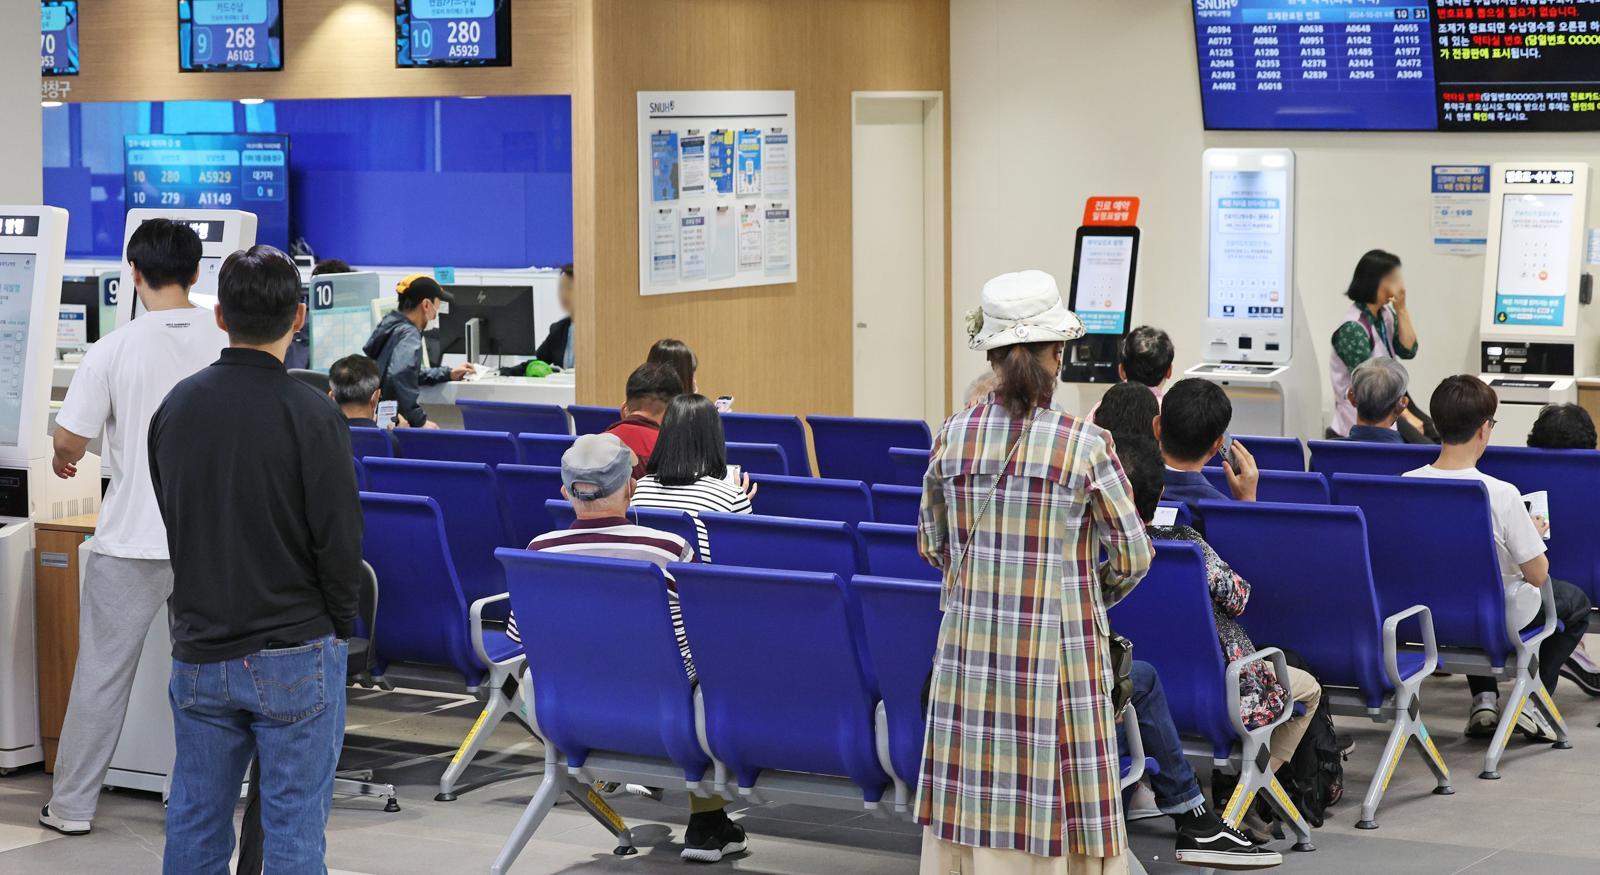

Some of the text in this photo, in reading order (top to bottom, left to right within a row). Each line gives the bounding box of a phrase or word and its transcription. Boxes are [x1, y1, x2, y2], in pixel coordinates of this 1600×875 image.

[1396, 10, 1408, 18] 10
[1416, 10, 1426, 18] 31
[447, 21, 480, 43] 280
[1345, 24, 1371, 32] A0648
[1393, 24, 1419, 32] A0655
[226, 27, 255, 48] 268
[412, 28, 431, 48] 10
[1300, 36, 1324, 44] A0951
[1346, 36, 1372, 44] A1042
[1394, 36, 1420, 44] A1115
[1452, 36, 1470, 46] 있는
[198, 34, 207, 54] 9
[227, 50, 254, 62] A6103
[449, 45, 480, 56] A5929
[1348, 48, 1373, 56] A1485
[1395, 47, 1420, 56] A1977
[1440, 48, 1450, 59] 가
[1348, 59, 1374, 67] A2434
[1396, 59, 1422, 67] A2472
[650, 102, 670, 113] SNUH
[133, 170, 232, 183] 10 280 A5929
[134, 192, 232, 205] 10 279 A1149
[1095, 201, 1130, 211] 진료 예약
[109, 280, 118, 303] 9
[316, 285, 332, 306] 10
